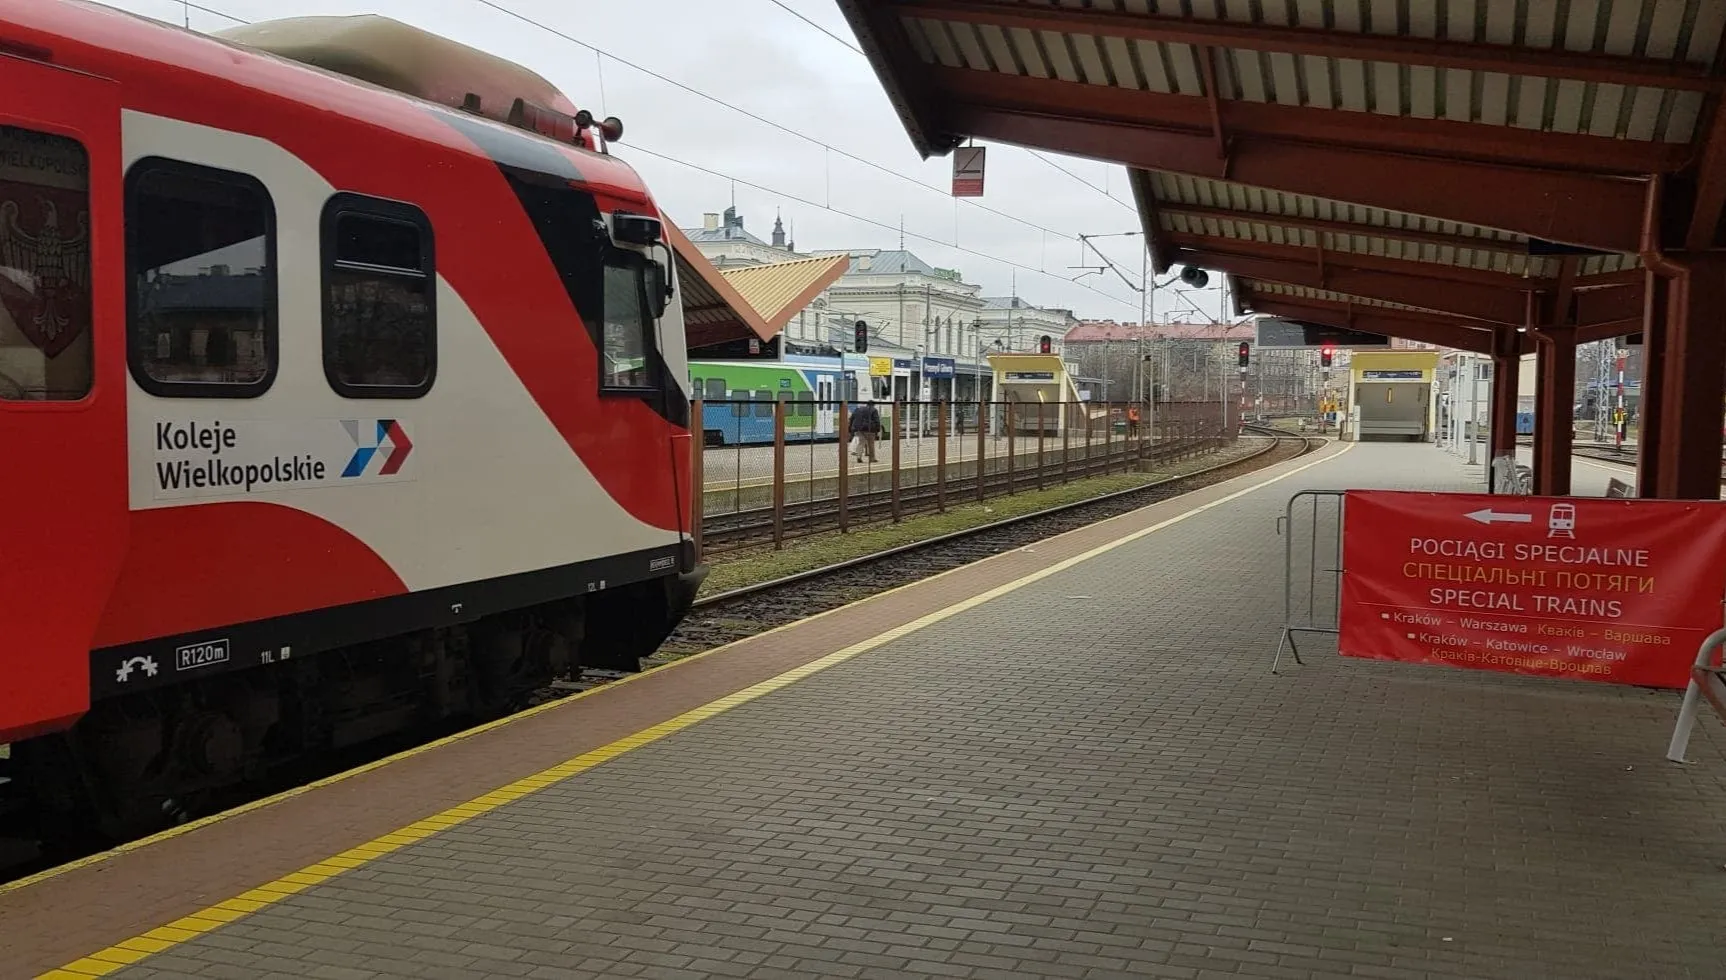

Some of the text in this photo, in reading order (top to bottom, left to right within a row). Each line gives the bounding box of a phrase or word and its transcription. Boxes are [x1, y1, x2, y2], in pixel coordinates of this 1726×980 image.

[156, 420, 236, 455] Koleje
[156, 455, 326, 492] Wielkopolskie
[1410, 537, 1650, 567] POCIĄGI SPECJALNE
[1403, 562, 1655, 594] СПЕЦІАЛЬНІ ПОТЯГИ
[1429, 588, 1622, 618] SPECIAL TRAINS
[1393, 611, 1441, 626] Kraków
[1460, 617, 1527, 633] Warszawa
[1604, 629, 1671, 645] Варшава
[182, 645, 224, 666] R120m
[1419, 632, 1468, 646] Kraków
[1486, 638, 1548, 654] Katowice
[1567, 645, 1627, 661] Wrocław
